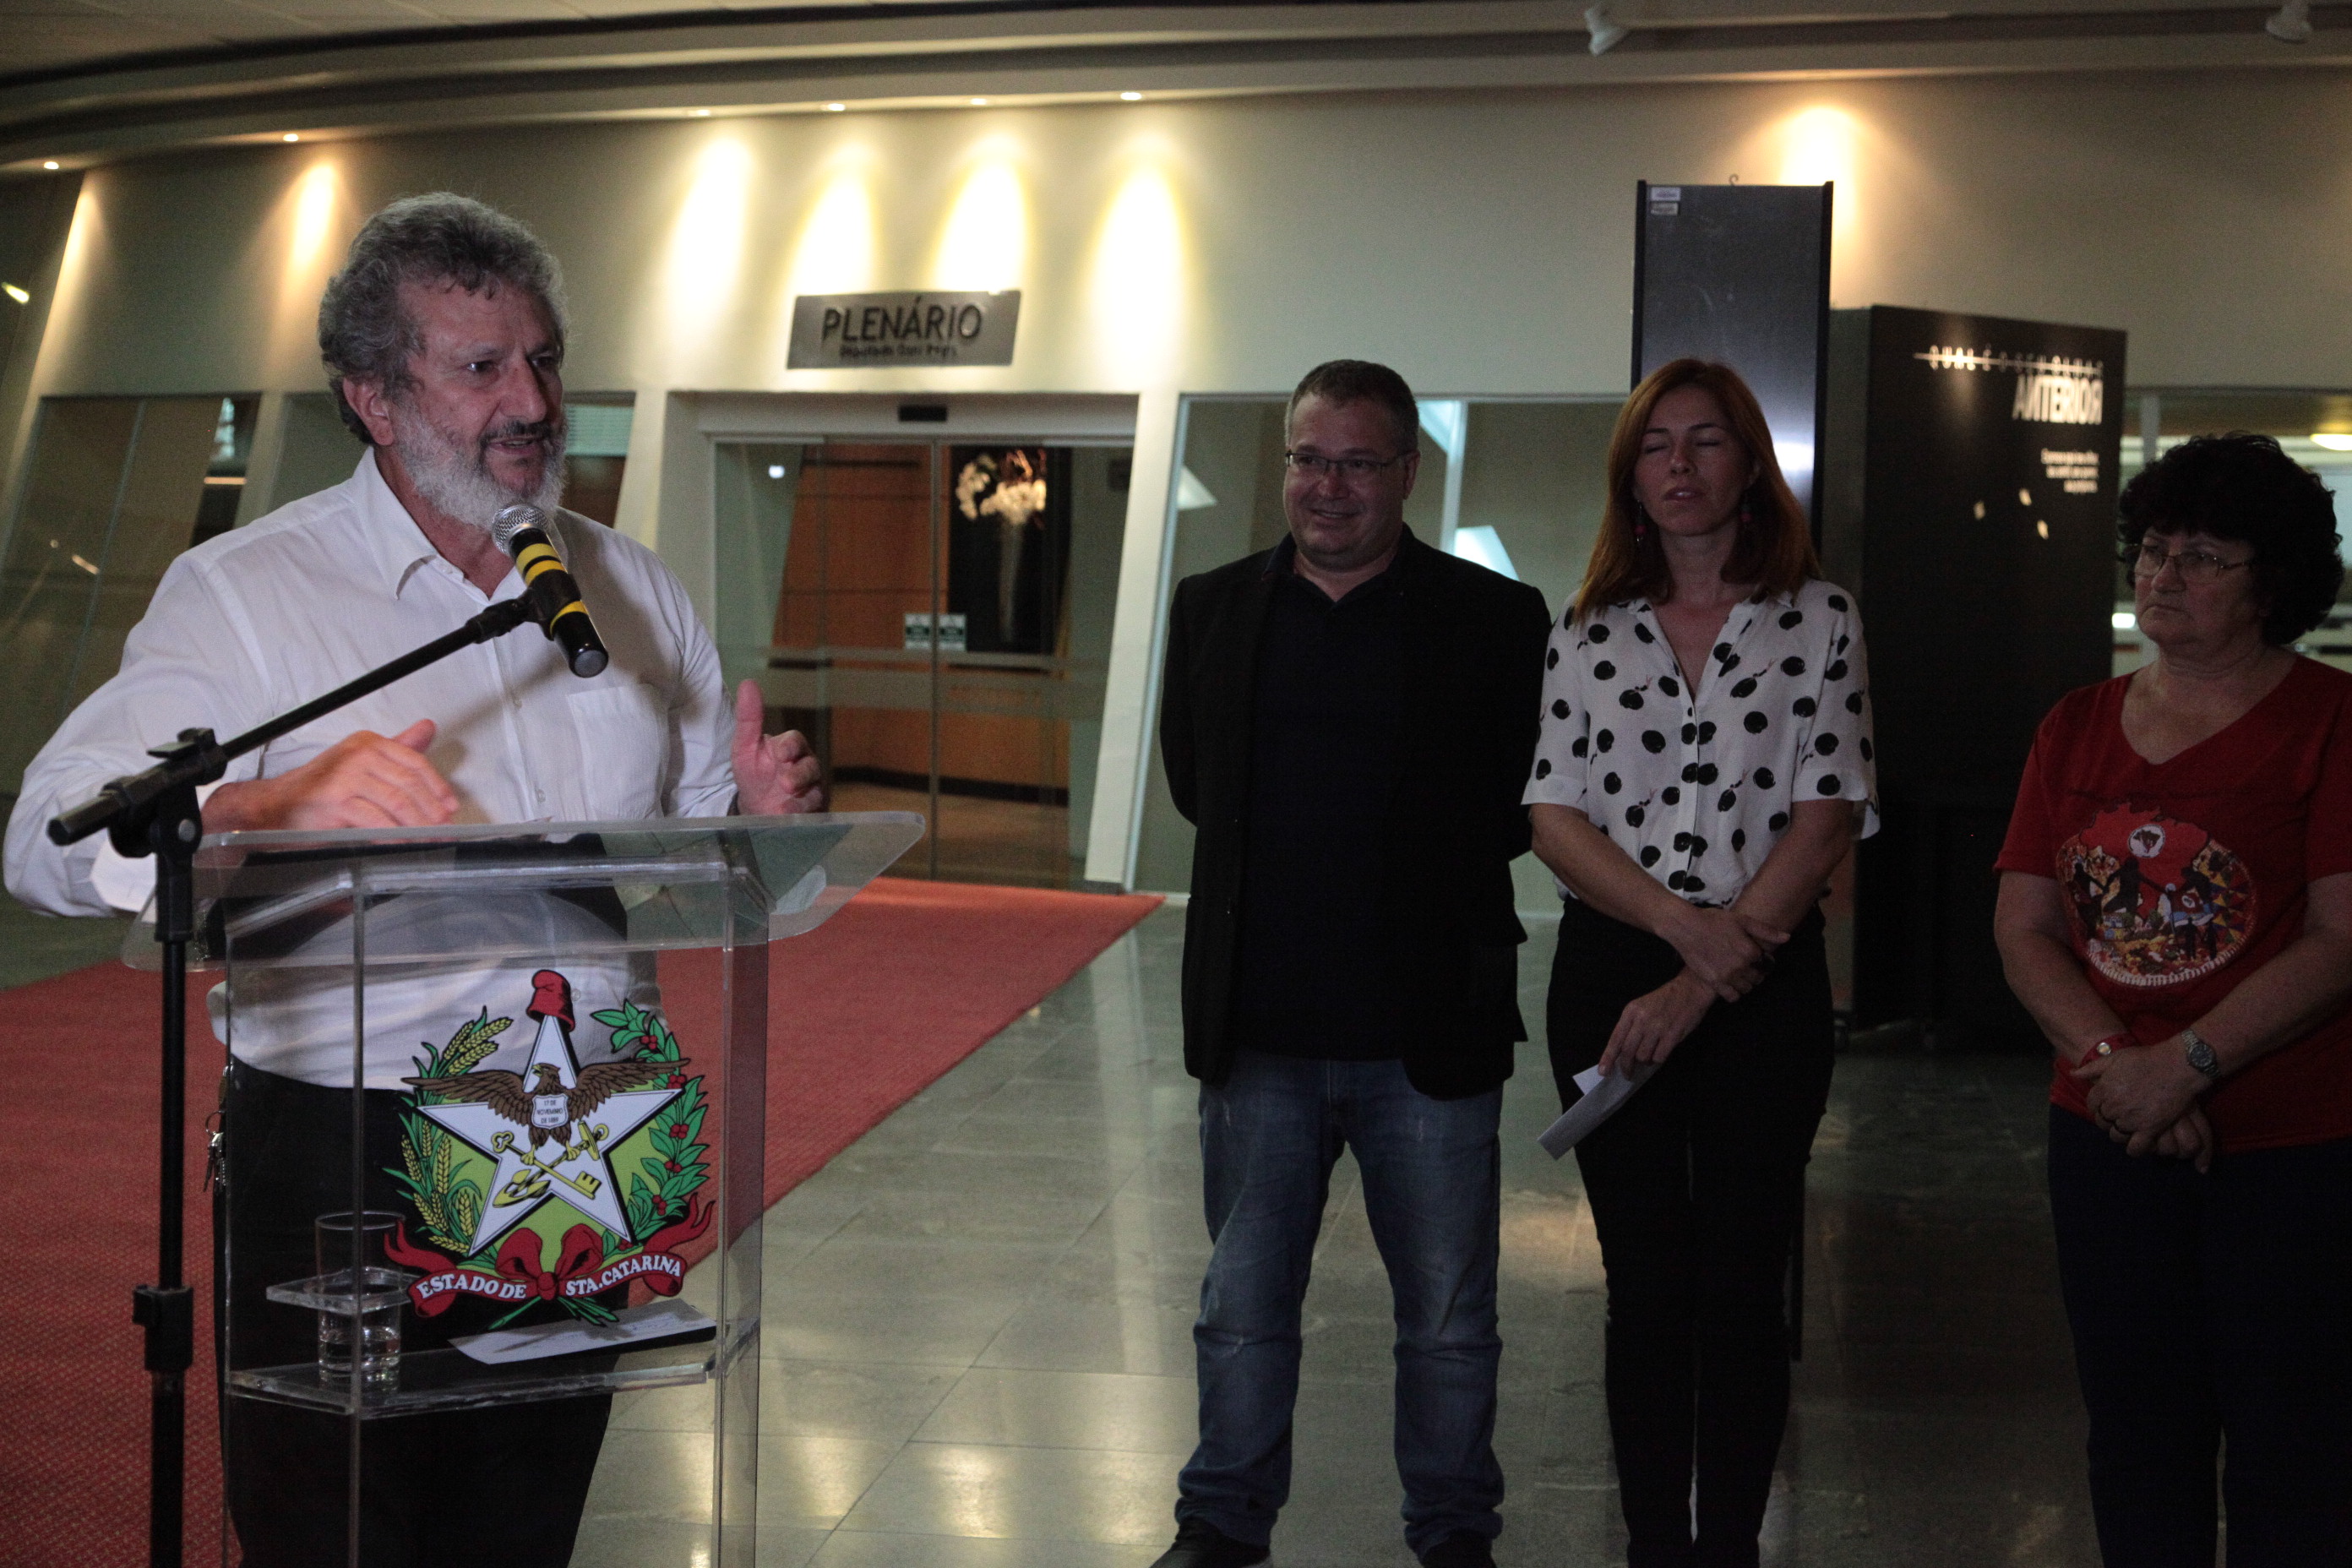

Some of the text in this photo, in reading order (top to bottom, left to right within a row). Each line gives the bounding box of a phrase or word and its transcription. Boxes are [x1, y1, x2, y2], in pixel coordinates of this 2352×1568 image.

[821, 296, 983, 341] PLENÁRIO
[416, 1273, 498, 1299] ESTADO
[498, 1283, 527, 1299] DE
